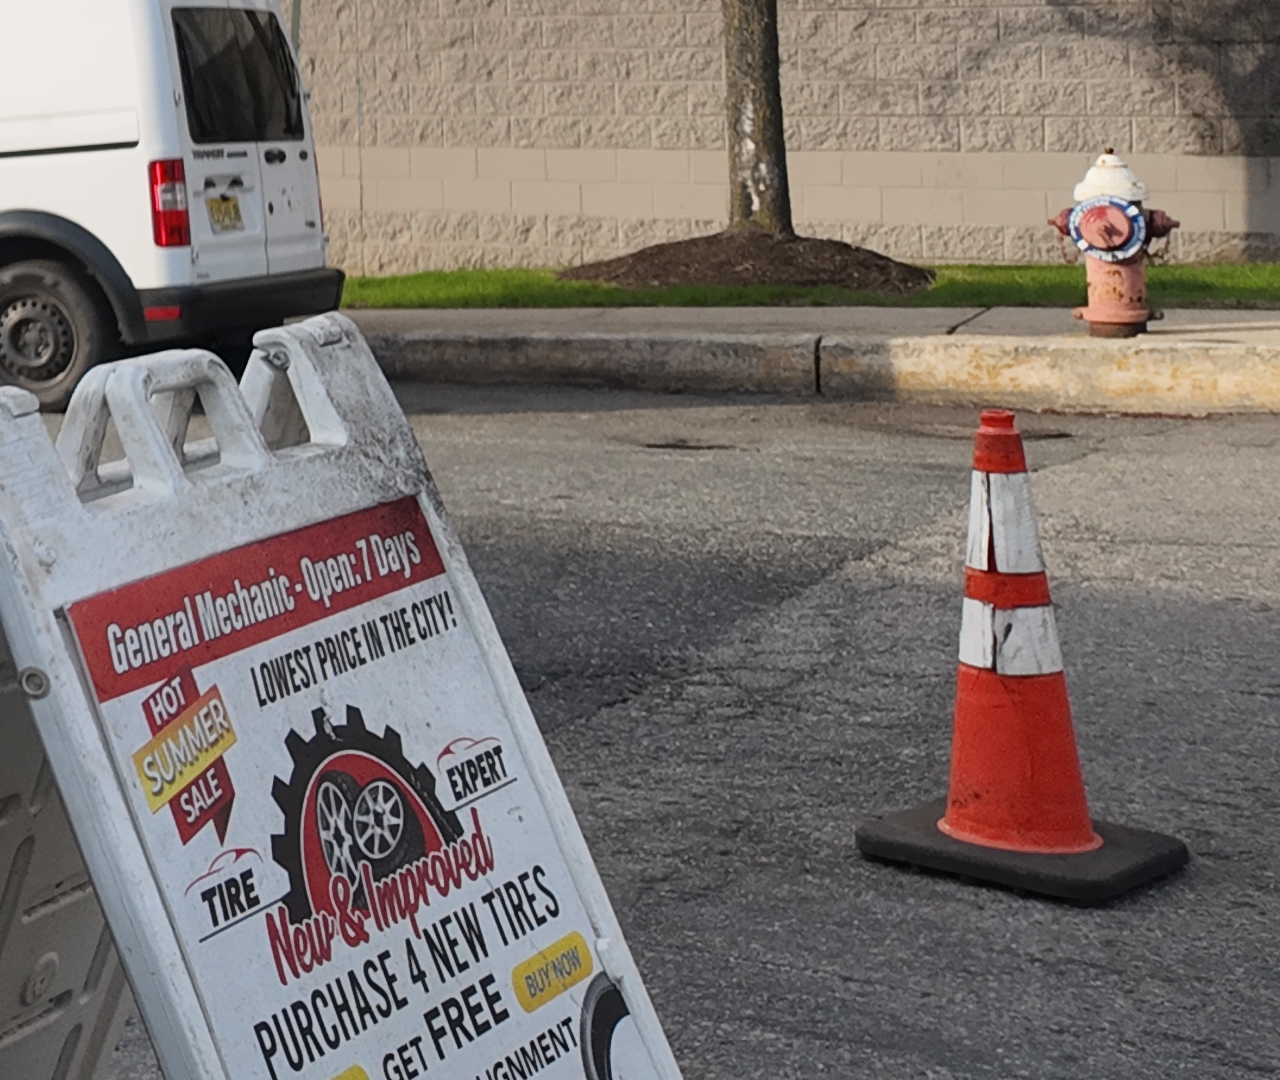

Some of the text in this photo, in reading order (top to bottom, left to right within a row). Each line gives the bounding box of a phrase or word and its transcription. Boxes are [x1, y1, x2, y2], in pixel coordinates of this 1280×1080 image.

[106, 594, 200, 675] General
[194, 567, 296, 643] Mechanic
[300, 551, 362, 608] Open:
[356, 538, 372, 582] 7
[370, 530, 422, 579] Days
[250, 590, 458, 708] LOWEST PRICE IN THE CITY!
[143, 698, 230, 795] SUMMER
[148, 676, 186, 726] HOT
[180, 768, 223, 824] SALE
[446, 745, 508, 802] EXPERT
[200, 868, 260, 928] TIRE
[266, 806, 494, 986] New & Improved
[253, 865, 561, 1080] PURCHASE 4 NEW TIRES
[523, 945, 585, 999] BUY NOW
[382, 973, 511, 1080] GET FREE
